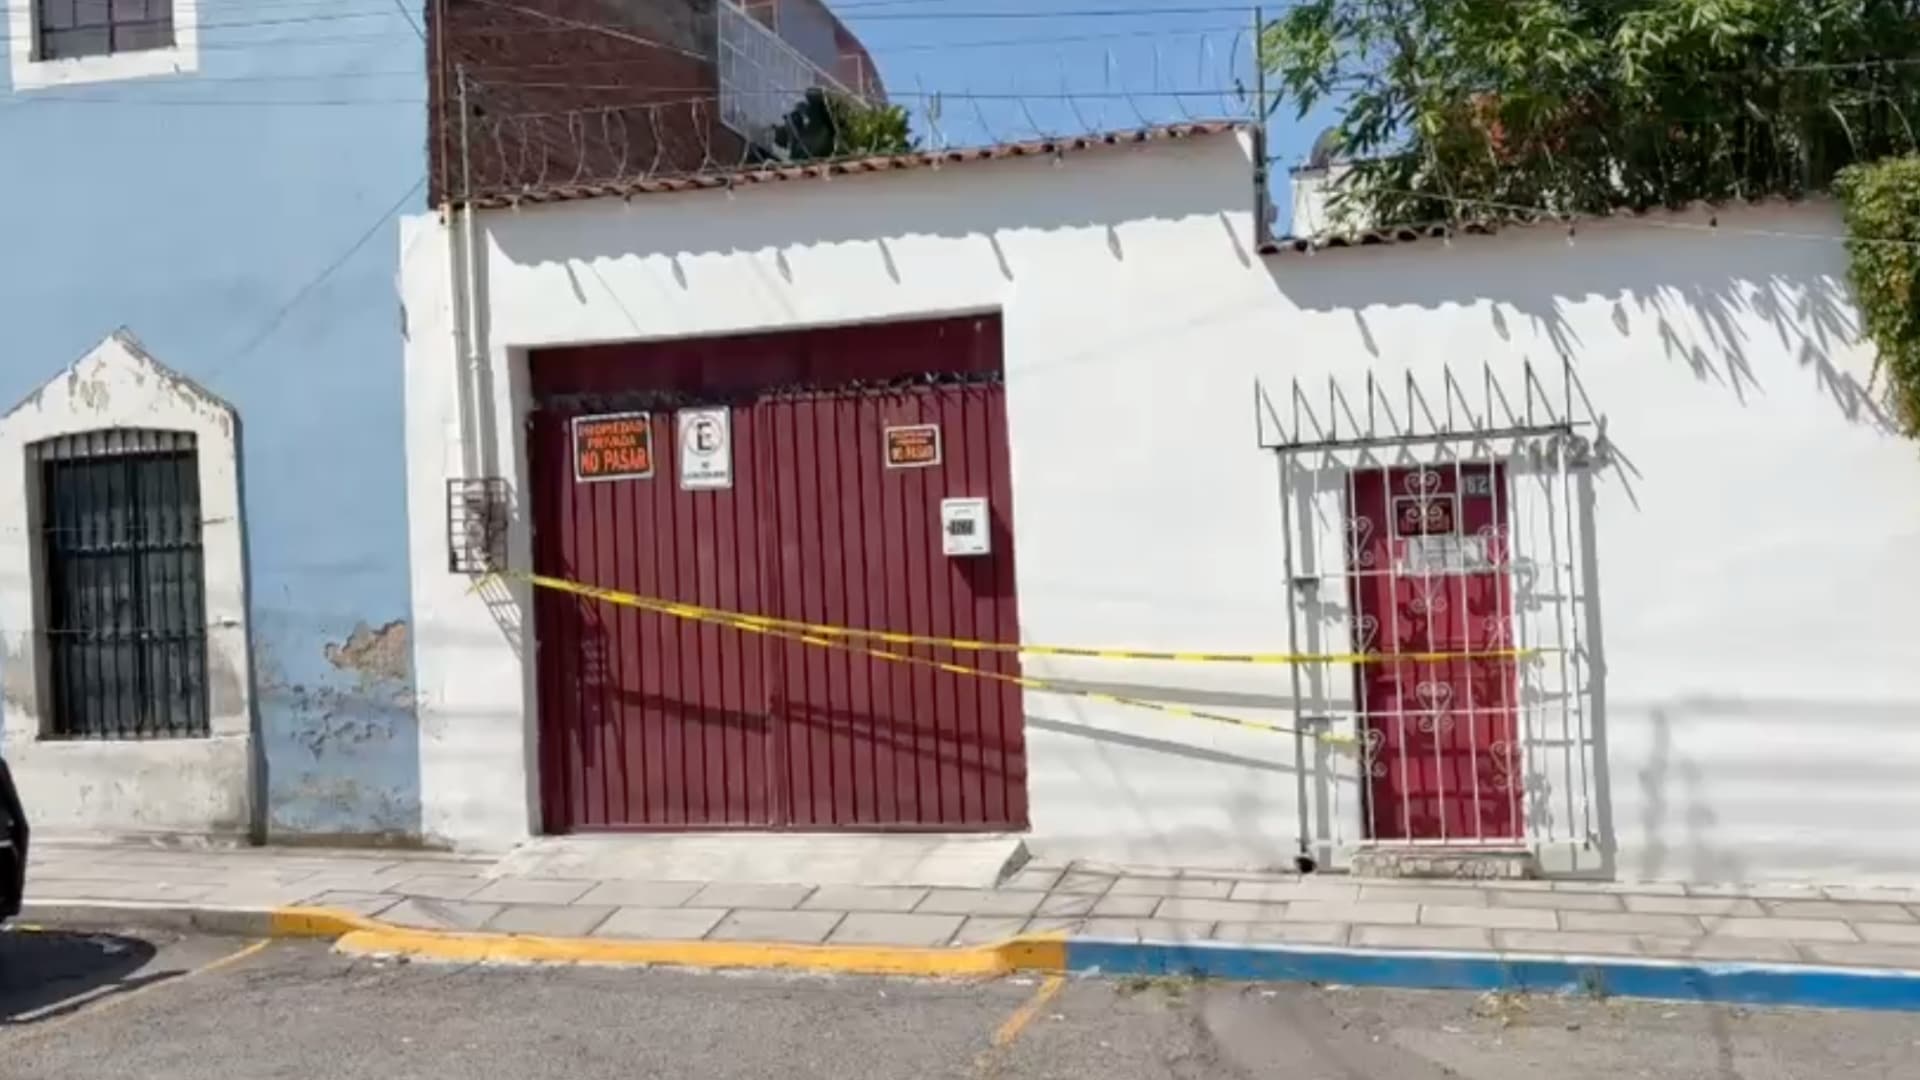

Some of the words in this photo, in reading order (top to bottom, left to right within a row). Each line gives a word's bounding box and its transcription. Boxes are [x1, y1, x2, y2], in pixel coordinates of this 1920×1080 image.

[697, 422, 711, 450] E
[581, 449, 599, 474] NO
[604, 447, 648, 472] PASAR
